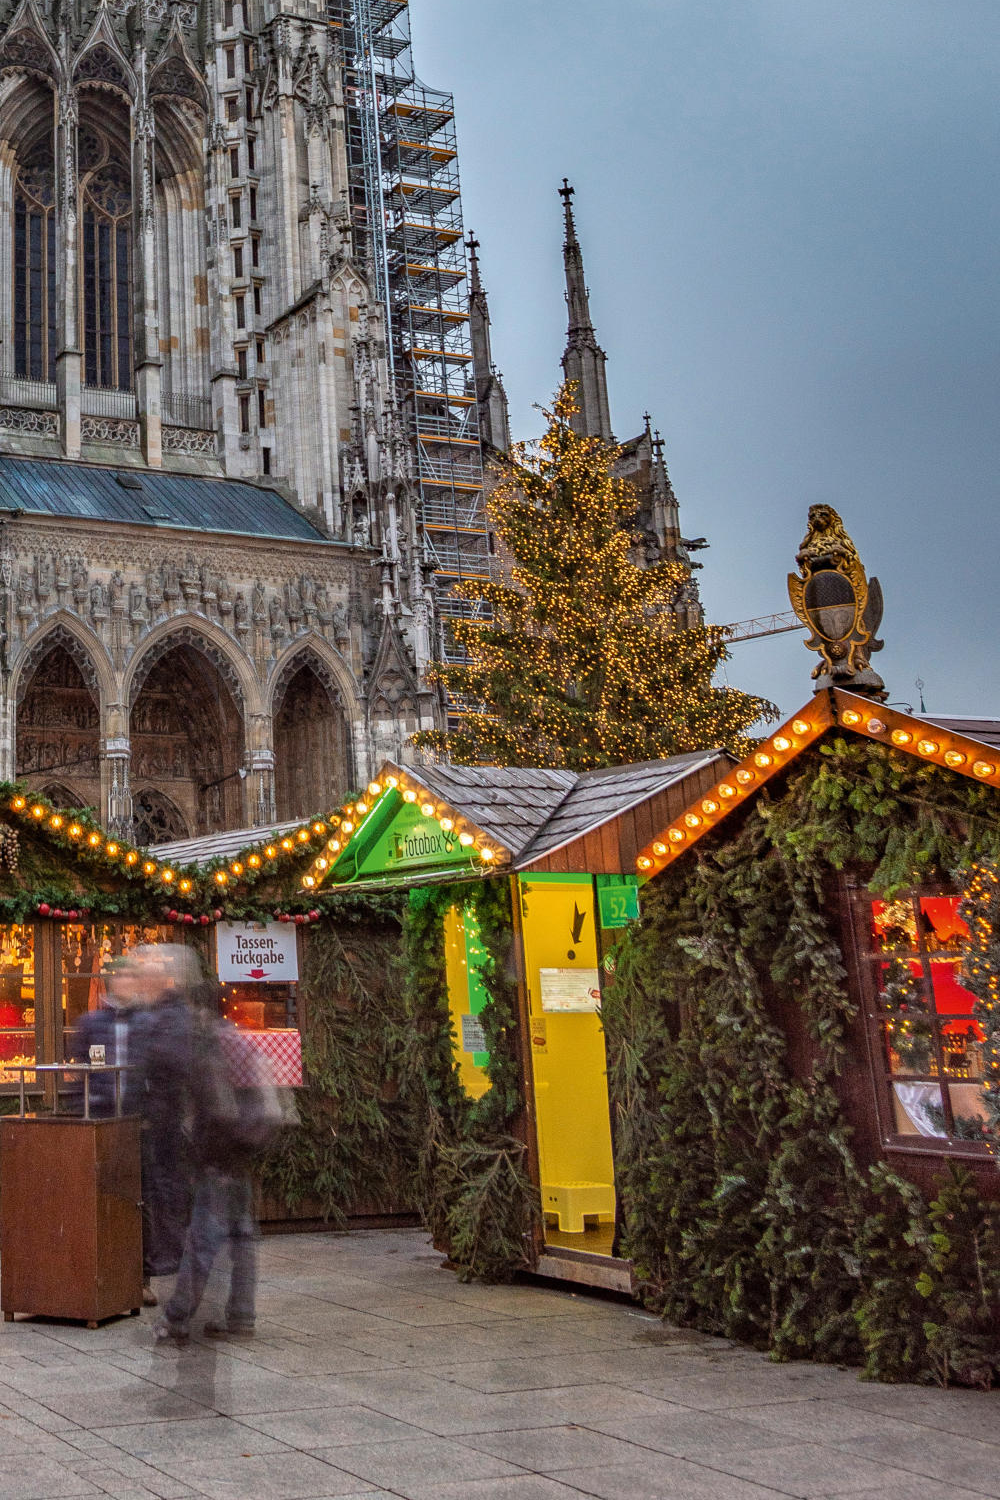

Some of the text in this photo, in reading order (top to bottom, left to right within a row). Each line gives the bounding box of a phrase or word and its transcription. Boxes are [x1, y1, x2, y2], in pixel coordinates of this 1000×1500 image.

[404, 832, 442, 857] fotobox
[610, 897, 628, 918] 52
[235, 935, 278, 949] Tassen-
[231, 950, 285, 967] rückgabe
